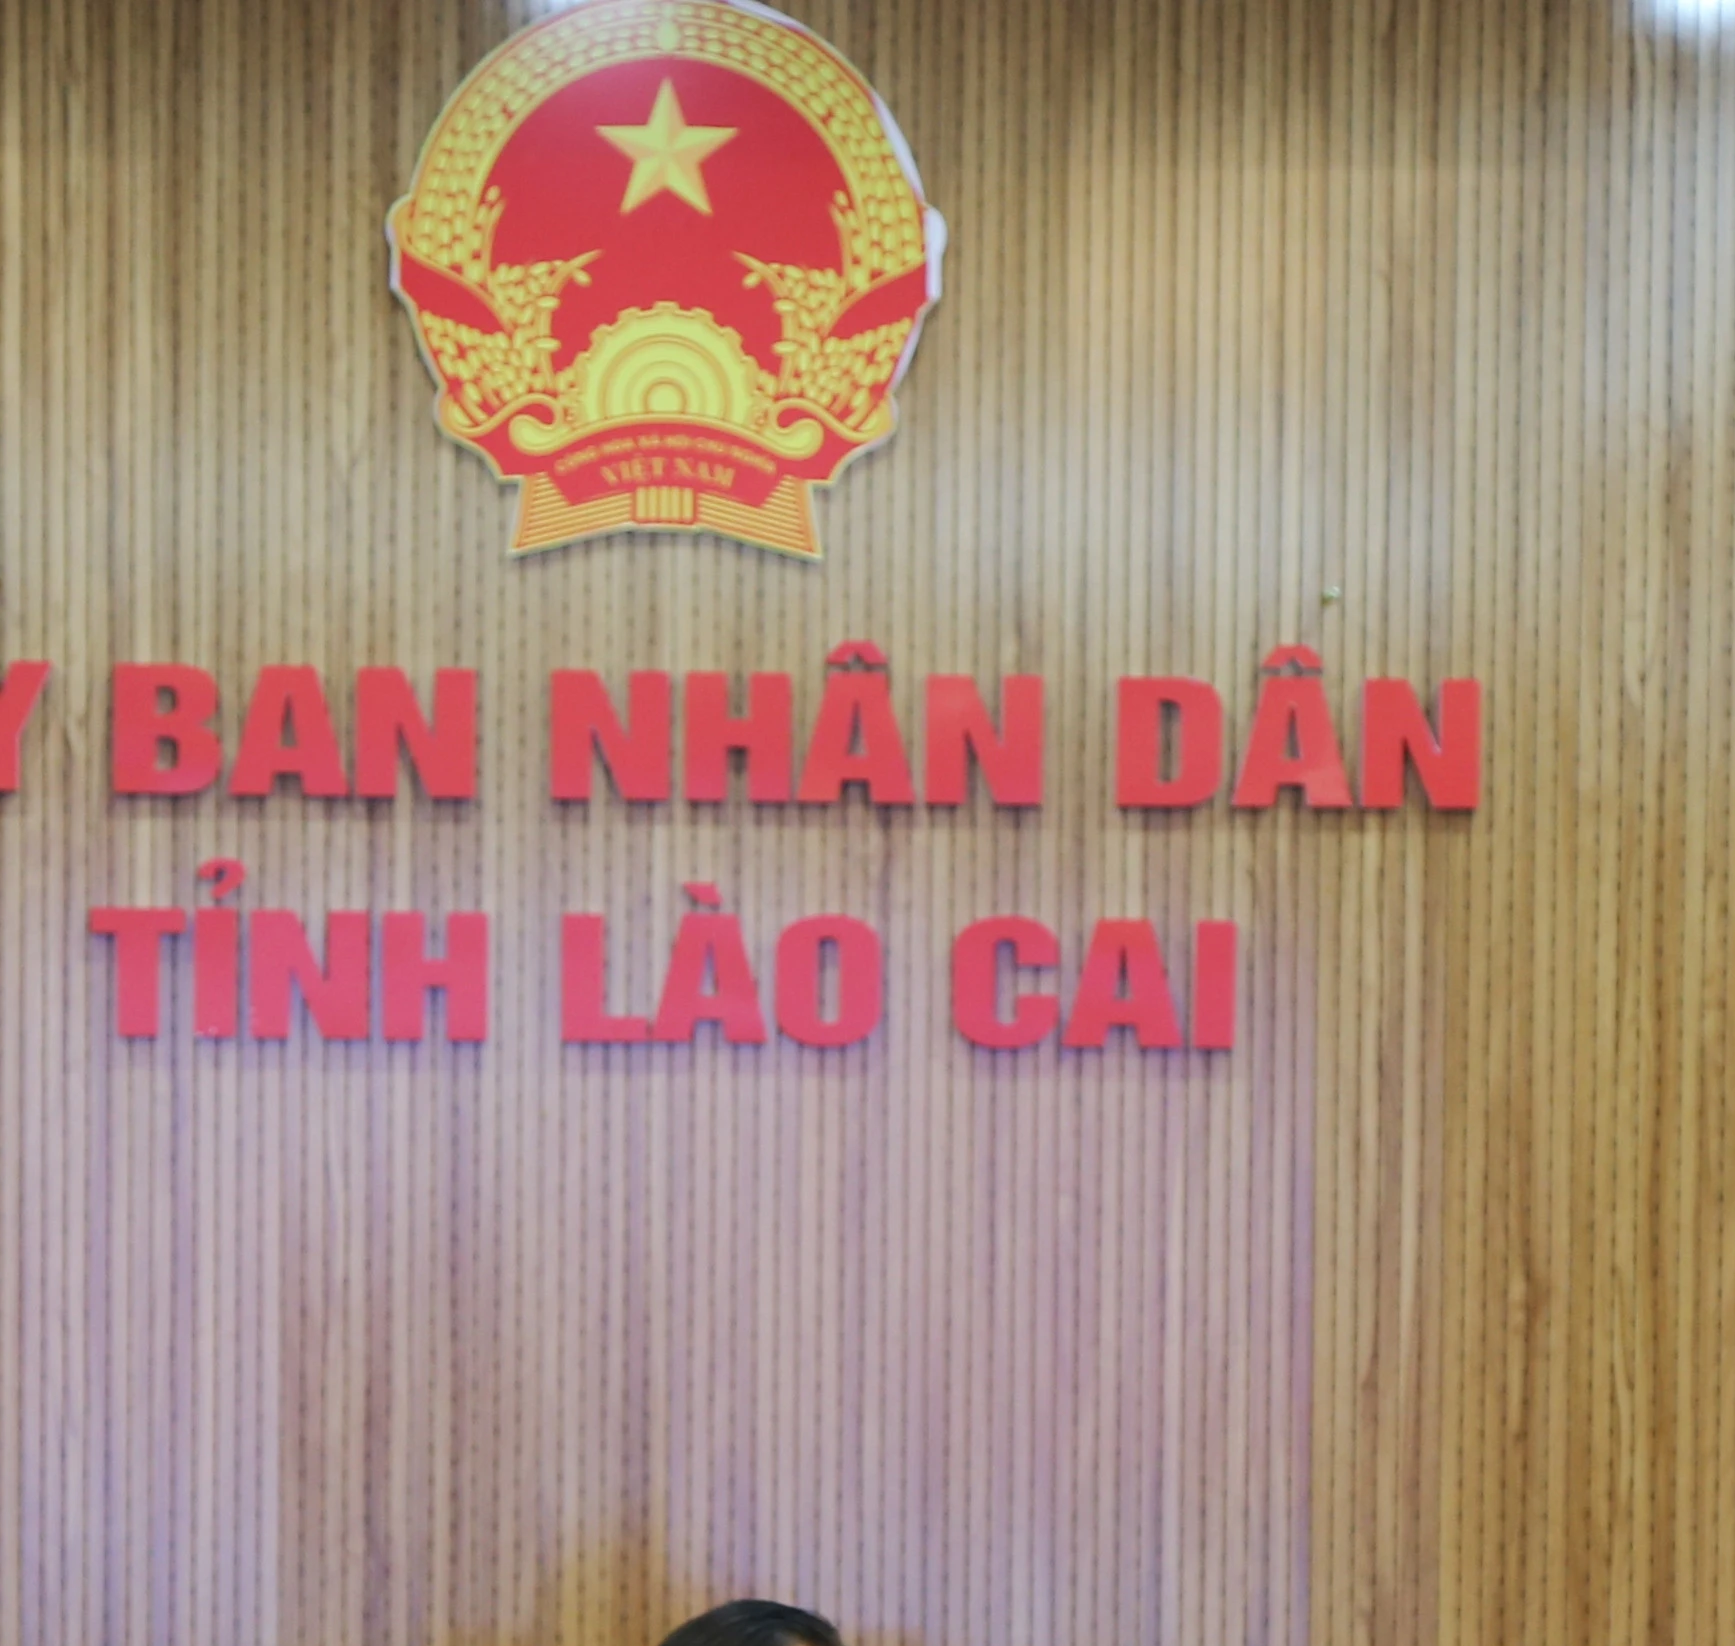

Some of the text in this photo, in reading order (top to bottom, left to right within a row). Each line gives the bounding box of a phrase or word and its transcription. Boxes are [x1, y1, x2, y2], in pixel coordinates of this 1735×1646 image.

[673, 457, 736, 489] NAM
[113, 663, 478, 799] BAN
[551, 641, 1044, 807] NHÂN
[1116, 645, 1482, 810] DÂN
[90, 857, 1238, 1050] TỈNH LÀO CAI
